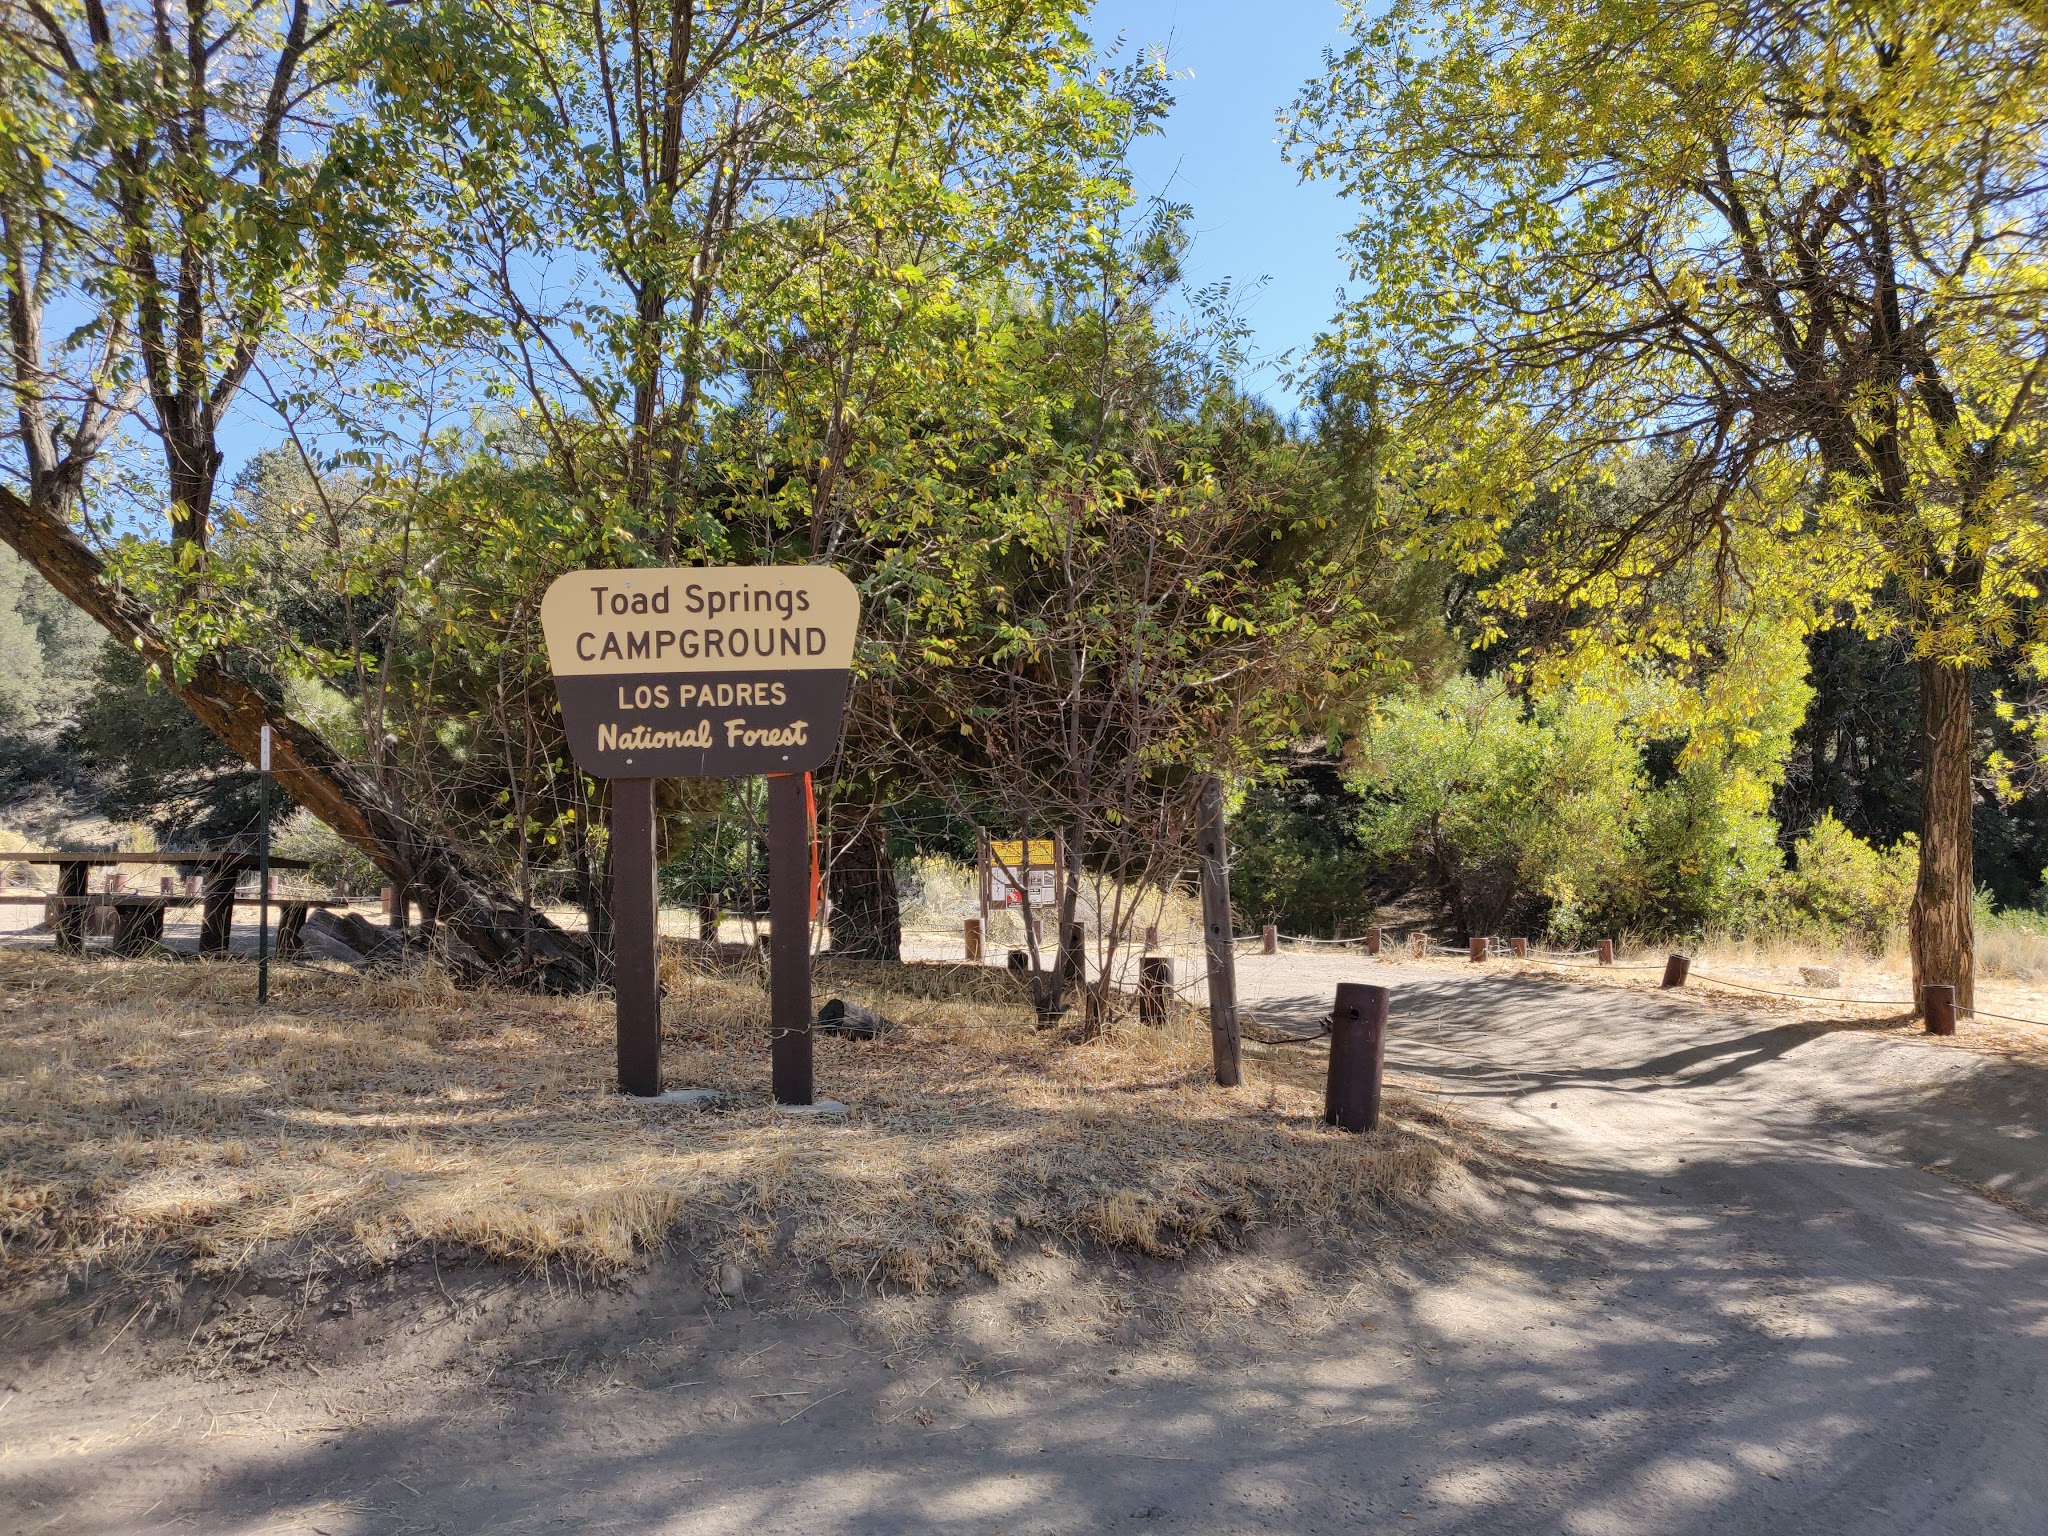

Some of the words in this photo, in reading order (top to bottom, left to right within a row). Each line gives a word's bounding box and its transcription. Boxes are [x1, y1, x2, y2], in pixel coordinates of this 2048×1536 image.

[591, 585, 669, 615] Toad
[685, 584, 809, 620] Springs
[577, 628, 826, 661] CAMPGROUND
[619, 685, 669, 709] LOS
[681, 683, 786, 707] PADRES
[598, 720, 712, 751] National
[724, 719, 808, 747] Forest
